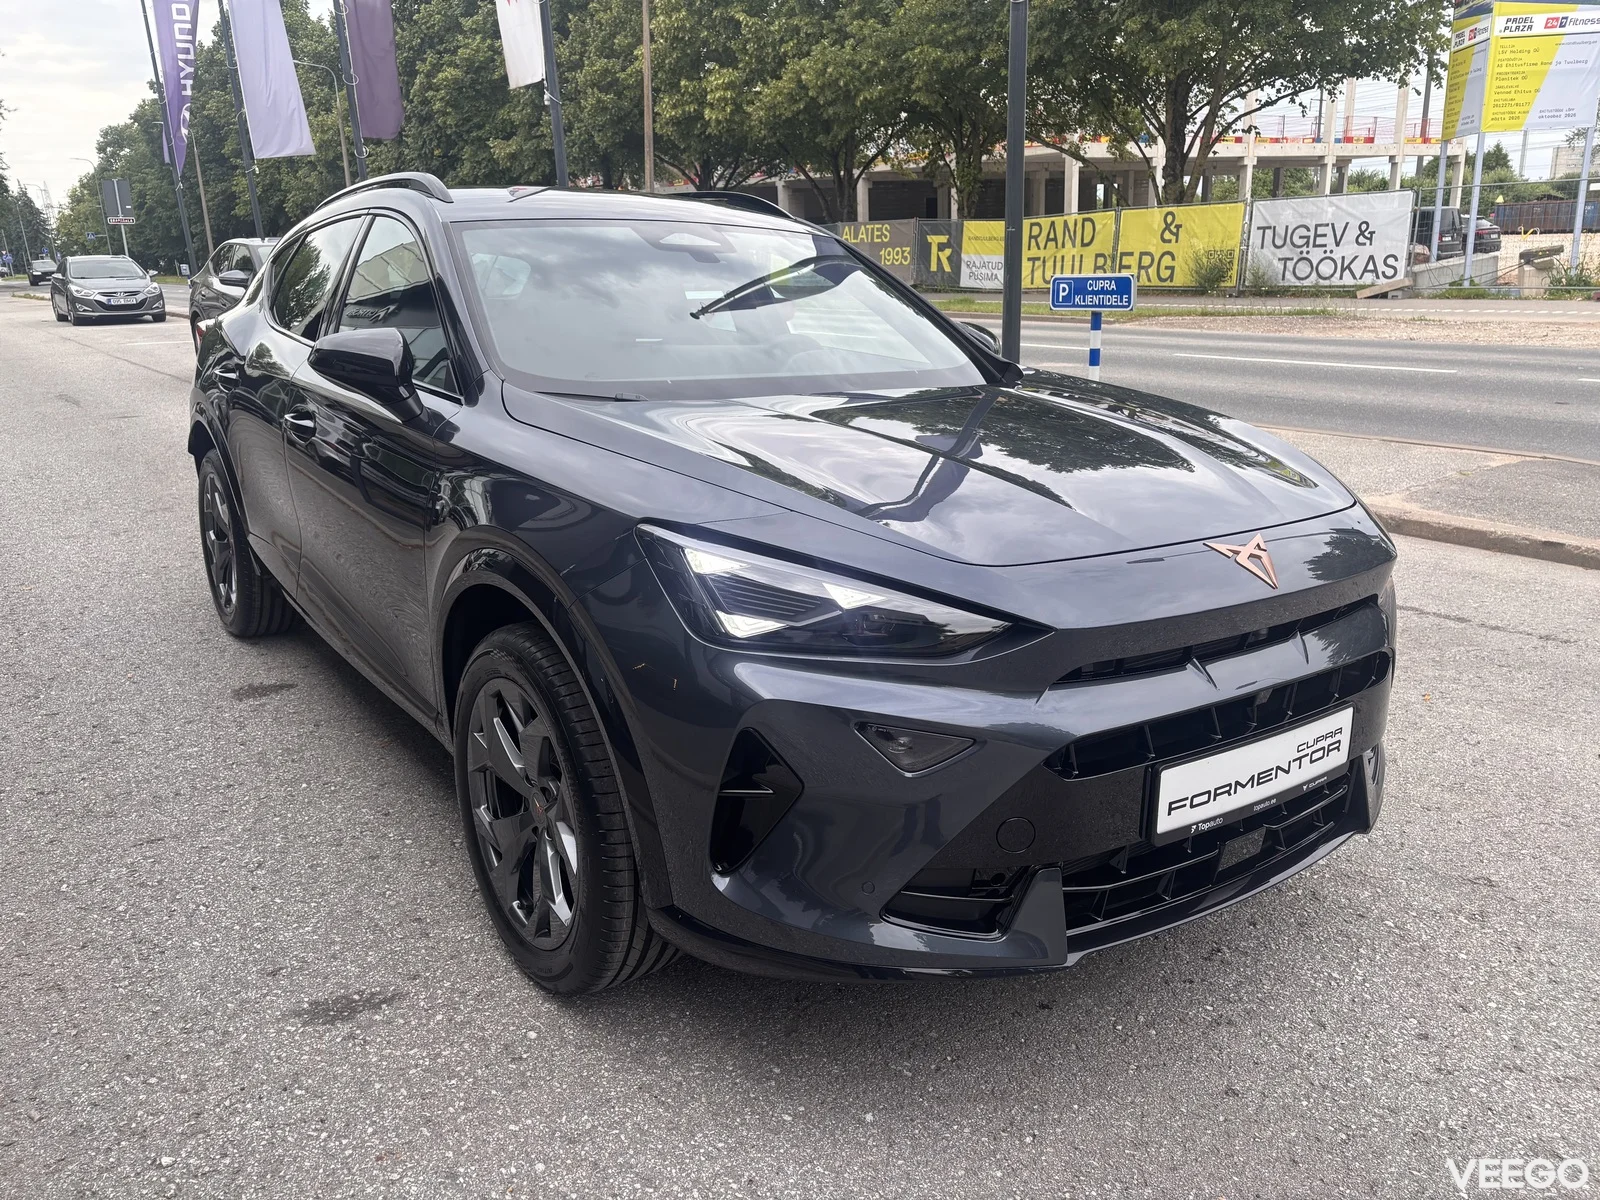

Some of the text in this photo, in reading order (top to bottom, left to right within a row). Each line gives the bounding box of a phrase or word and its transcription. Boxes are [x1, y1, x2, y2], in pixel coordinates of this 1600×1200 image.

[1506, 16, 1534, 24] PADEL
[171, 0, 194, 96] HYUND
[842, 224, 890, 242] ALATES
[1028, 211, 1182, 250] RAND &
[1256, 220, 1376, 250] TUGEV &
[880, 247, 910, 266] 1993
[966, 260, 1003, 270] RAJATUD
[1278, 249, 1399, 281] TÖÖKAS
[968, 270, 999, 282] PÜSIMA
[1087, 279, 1116, 291] CUPRA
[1074, 294, 1128, 306] KLIENTIDELE
[1297, 727, 1342, 753] CUPRA
[1168, 740, 1342, 816] FORMENTOR
[1309, 776, 1327, 788] CUPRA
[1253, 798, 1276, 812] topauto.ee
[1198, 817, 1224, 831] Topauto
